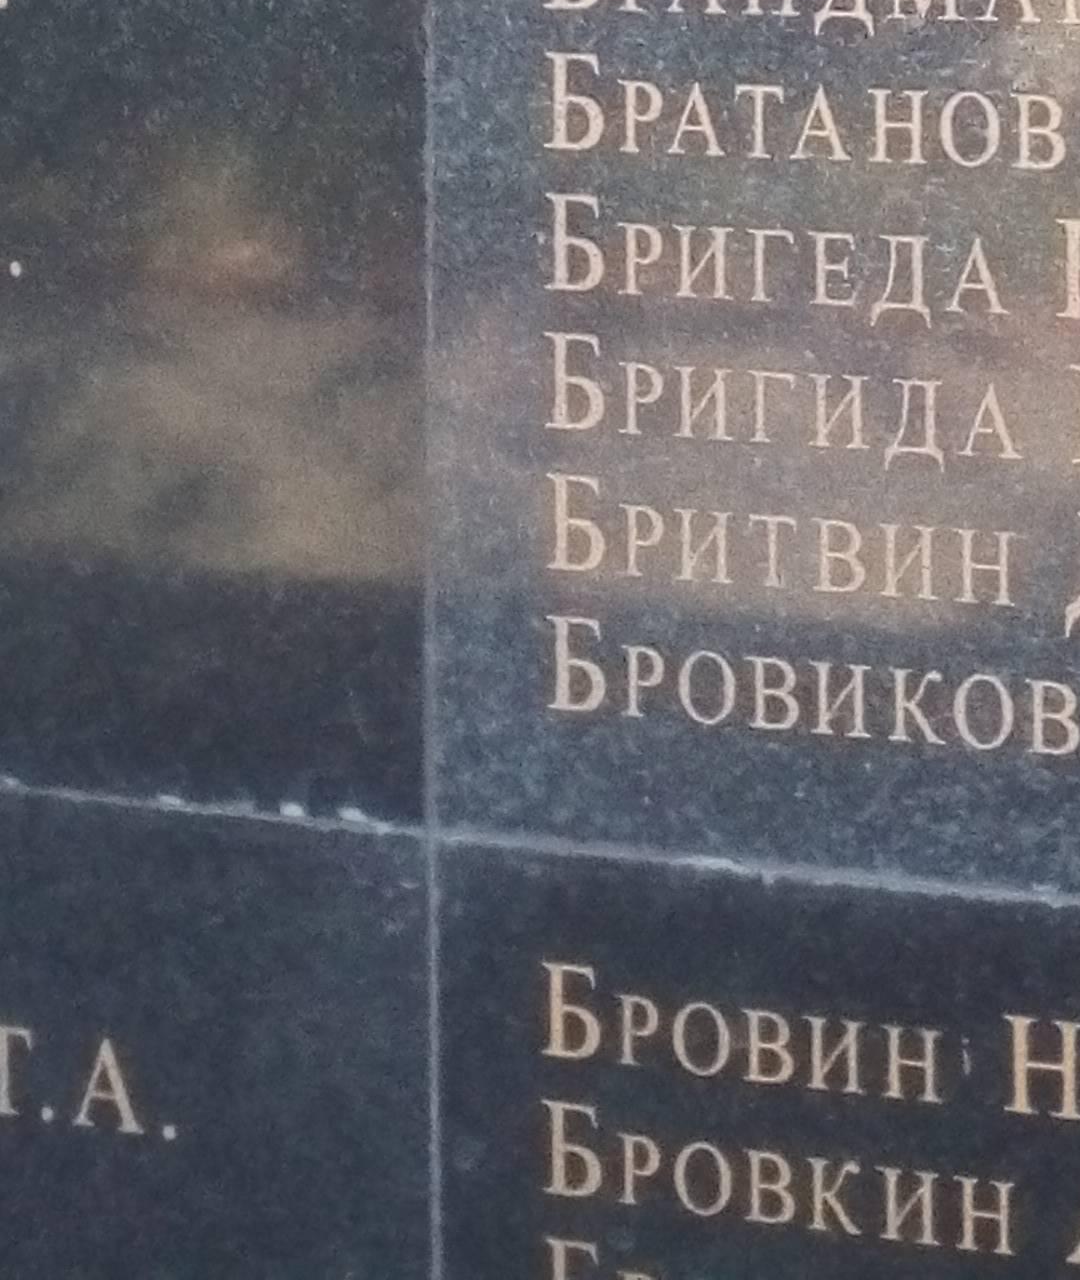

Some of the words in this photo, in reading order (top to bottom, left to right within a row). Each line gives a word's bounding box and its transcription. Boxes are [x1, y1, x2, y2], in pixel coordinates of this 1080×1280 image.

[543, 52, 1067, 173] БРАТАНОВ
[543, 192, 1010, 329] БРИГЕДА
[544, 331, 1024, 474] БРИГИДА
[545, 473, 1018, 609] БРИТВИН
[539, 960, 945, 1105] БРОВИН
[540, 1098, 1019, 1257] БРОВКИН
